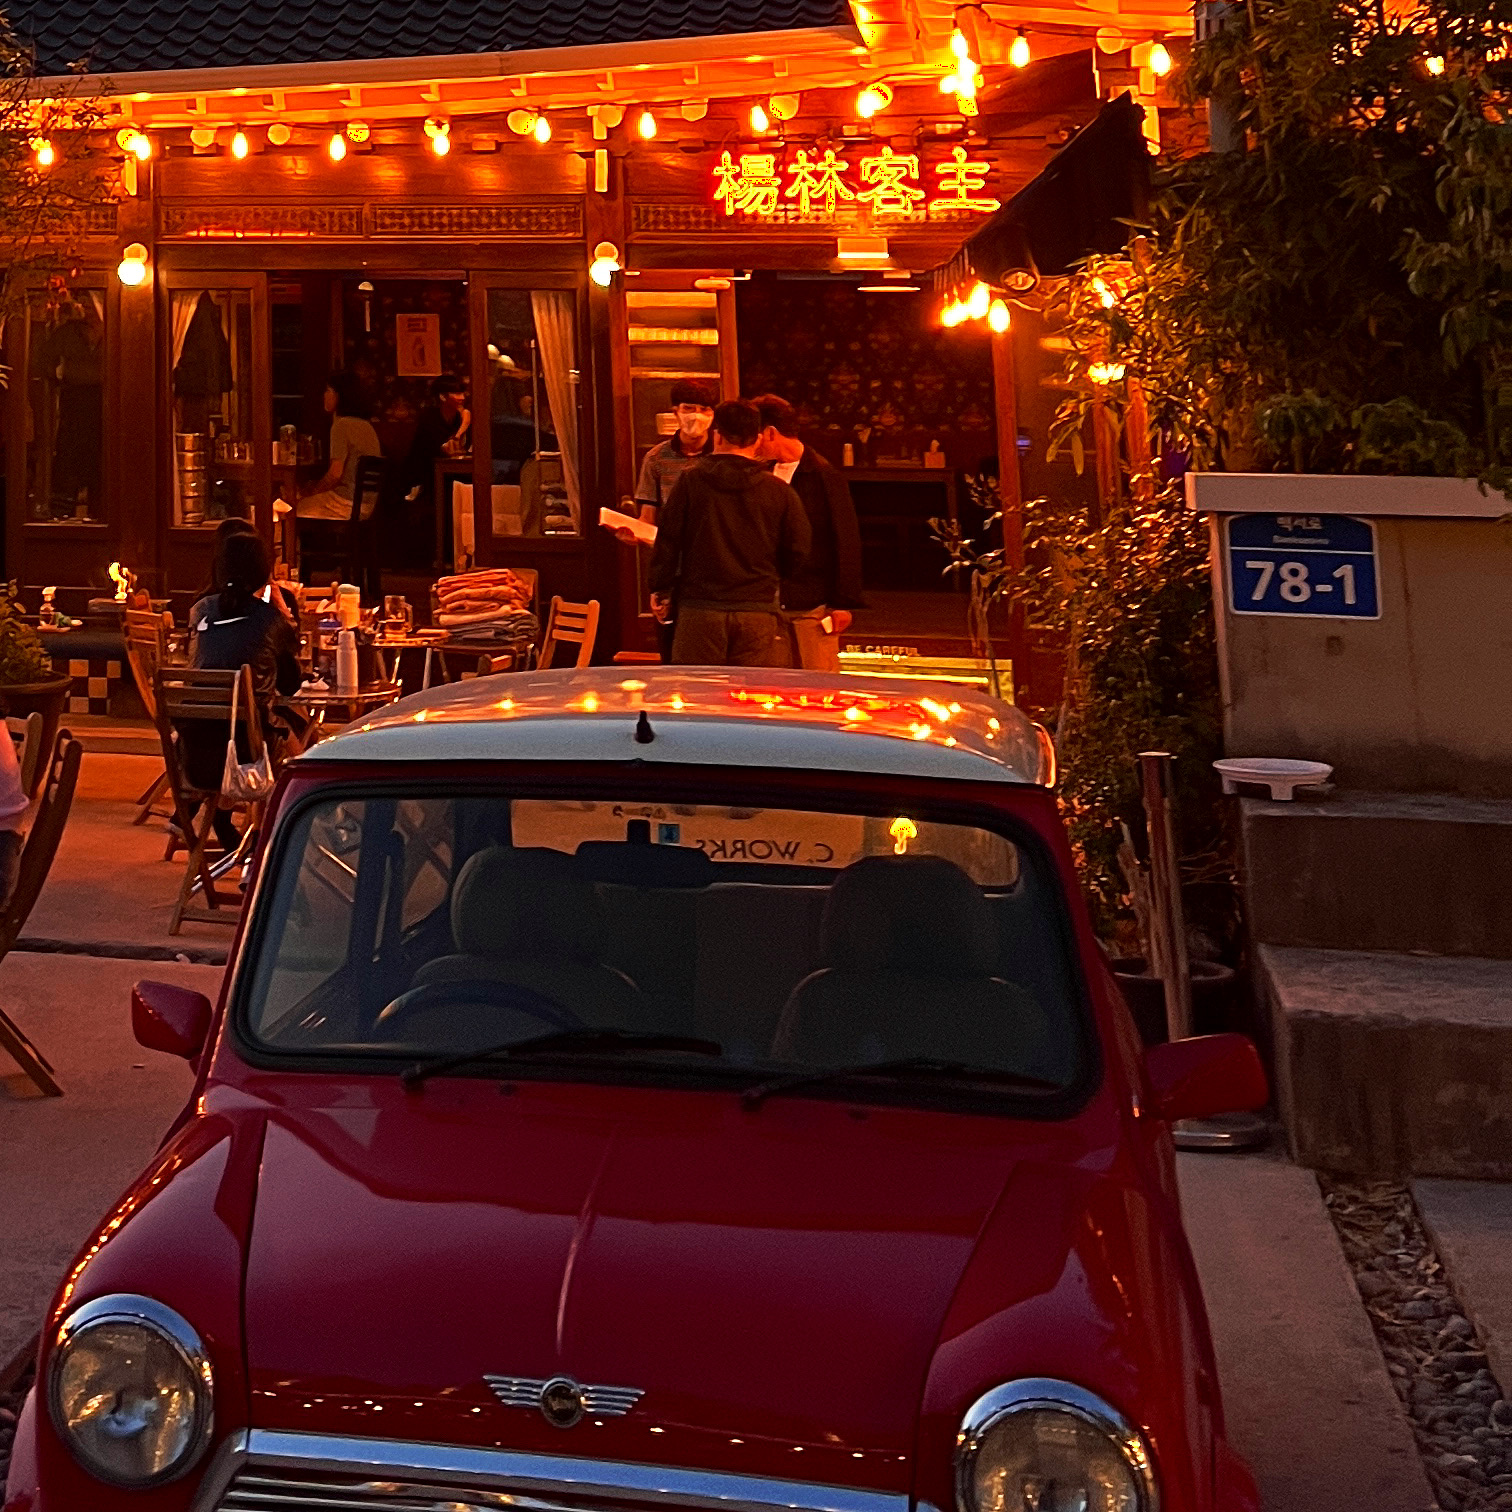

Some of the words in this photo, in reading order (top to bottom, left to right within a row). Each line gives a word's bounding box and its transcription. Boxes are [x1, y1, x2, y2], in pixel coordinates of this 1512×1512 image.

[712, 145, 1002, 216] 楊林客主
[1245, 560, 1356, 605] 78-1
